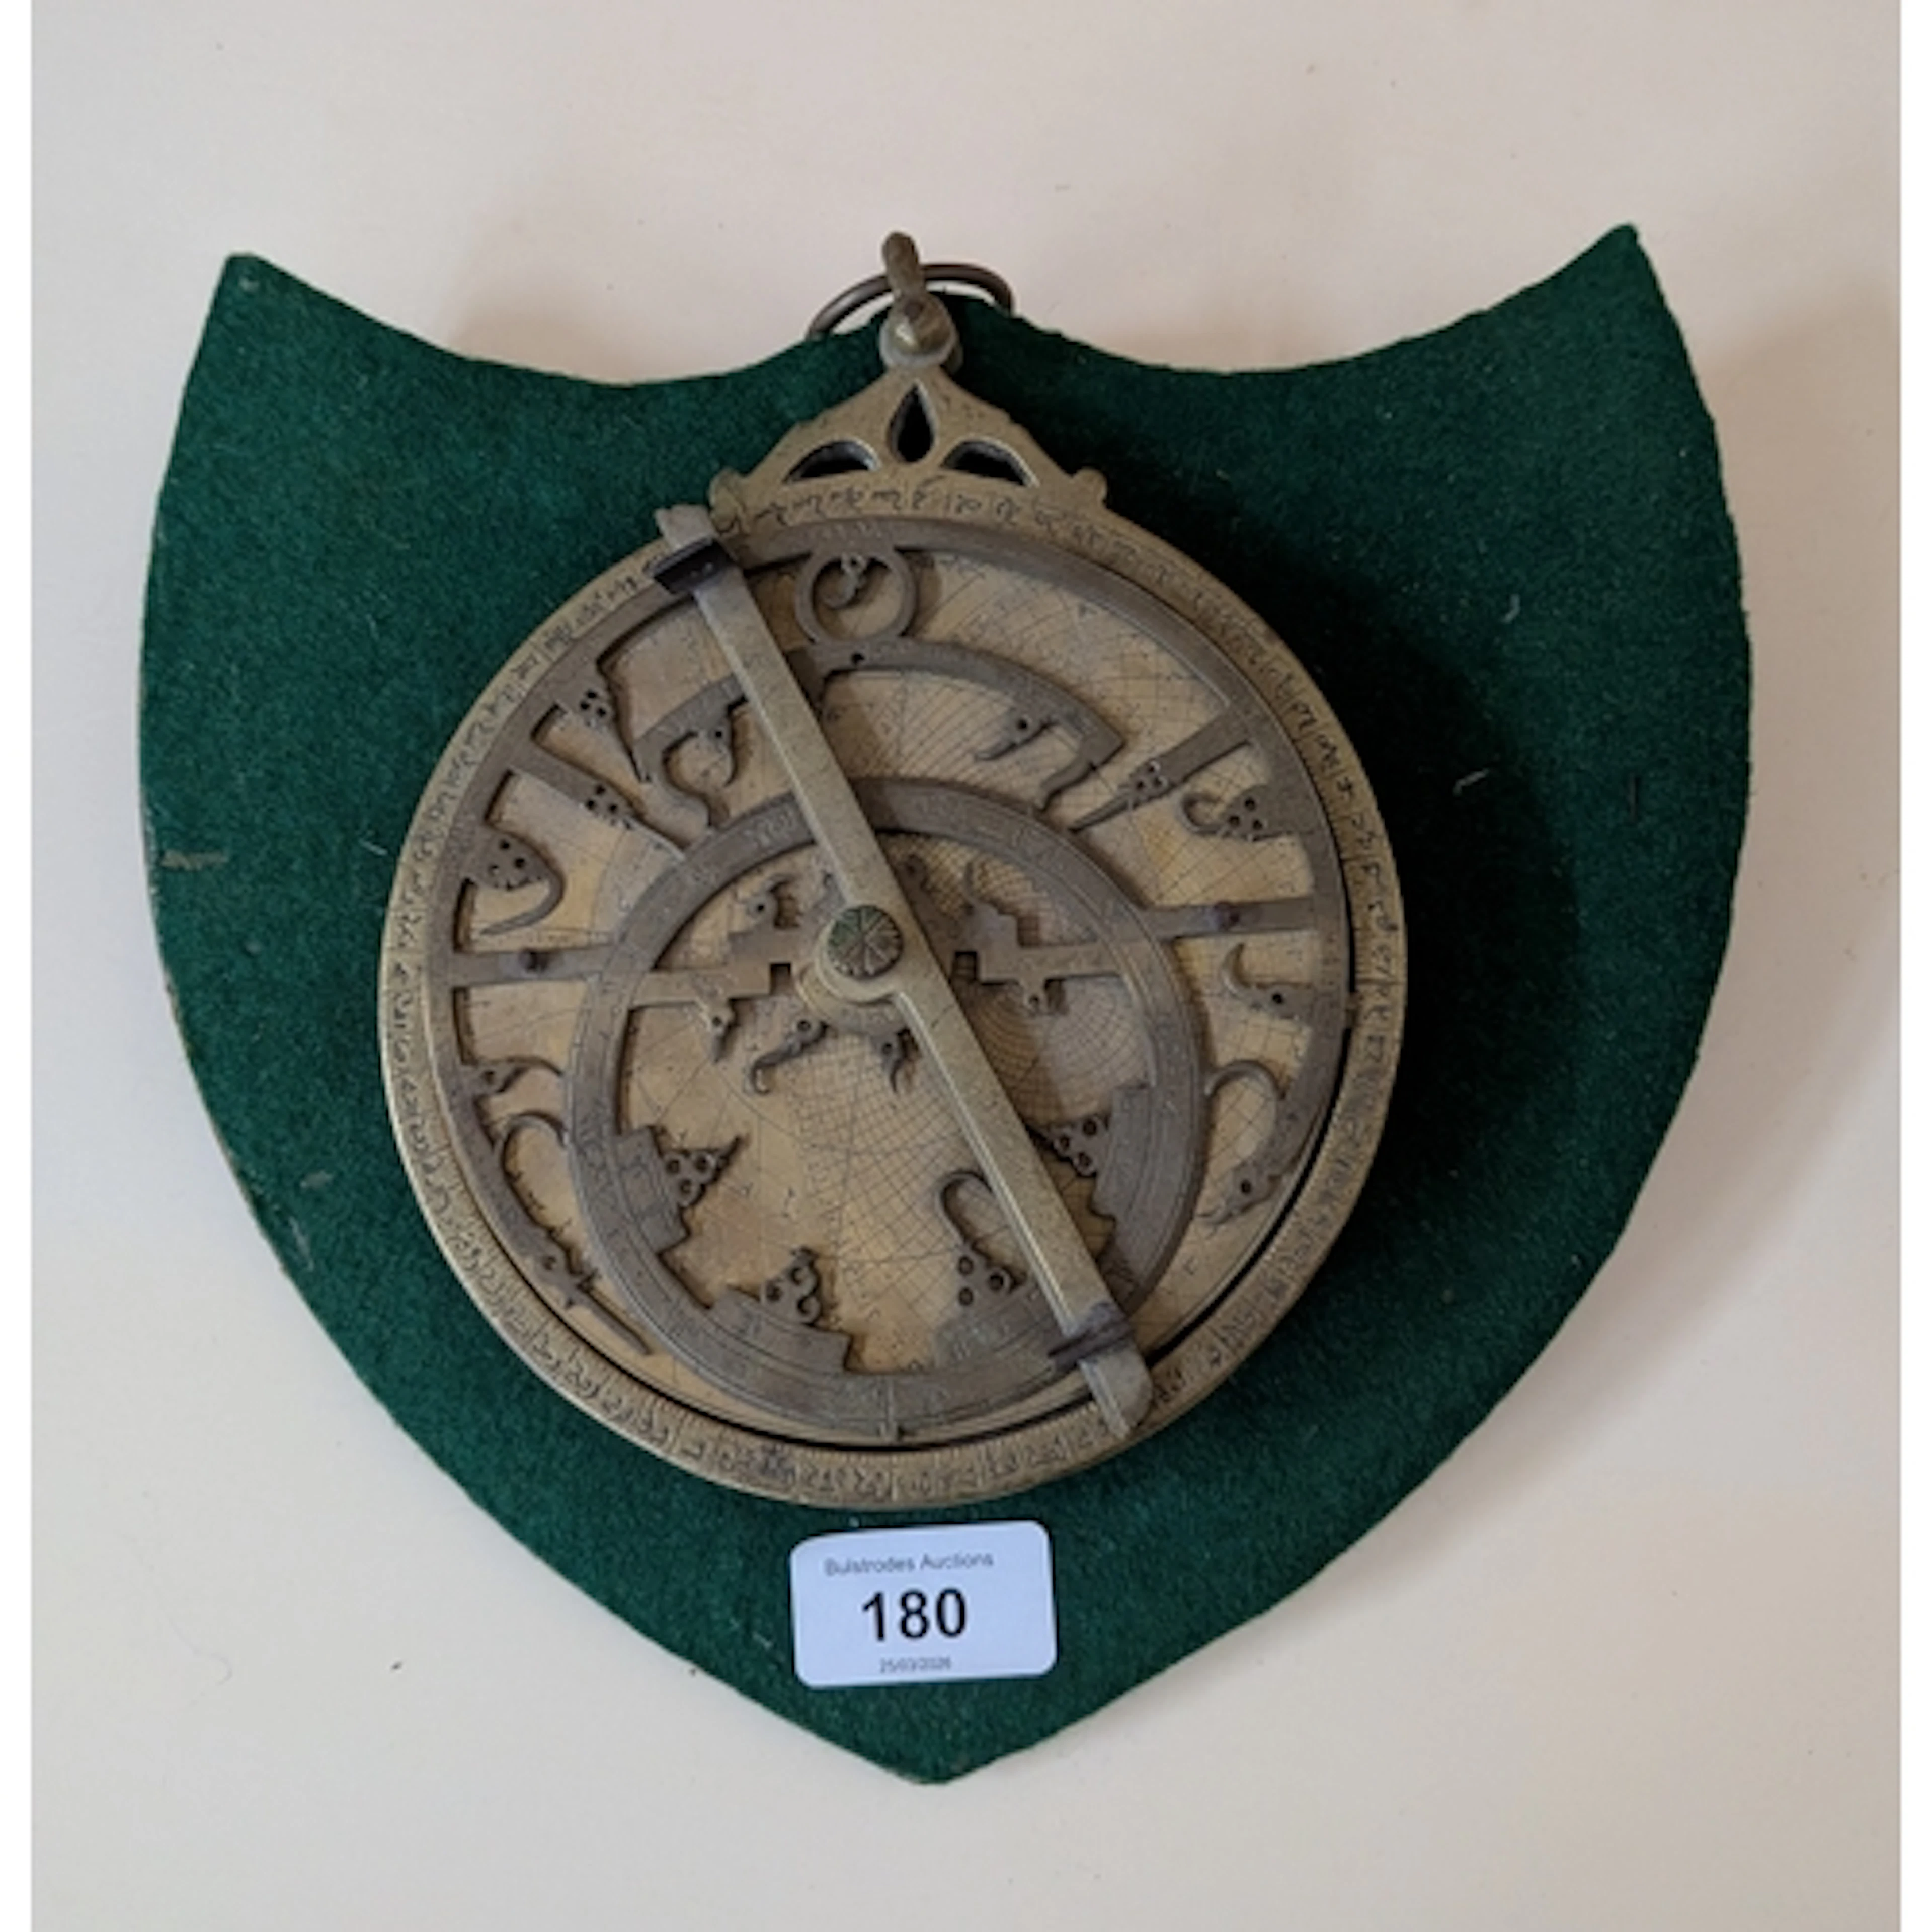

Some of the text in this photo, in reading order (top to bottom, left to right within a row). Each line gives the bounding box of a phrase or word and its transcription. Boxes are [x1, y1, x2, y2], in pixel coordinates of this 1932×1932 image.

[825, 1551, 994, 1576] Bulstrodes Auctions
[862, 1589, 966, 1641] 180
